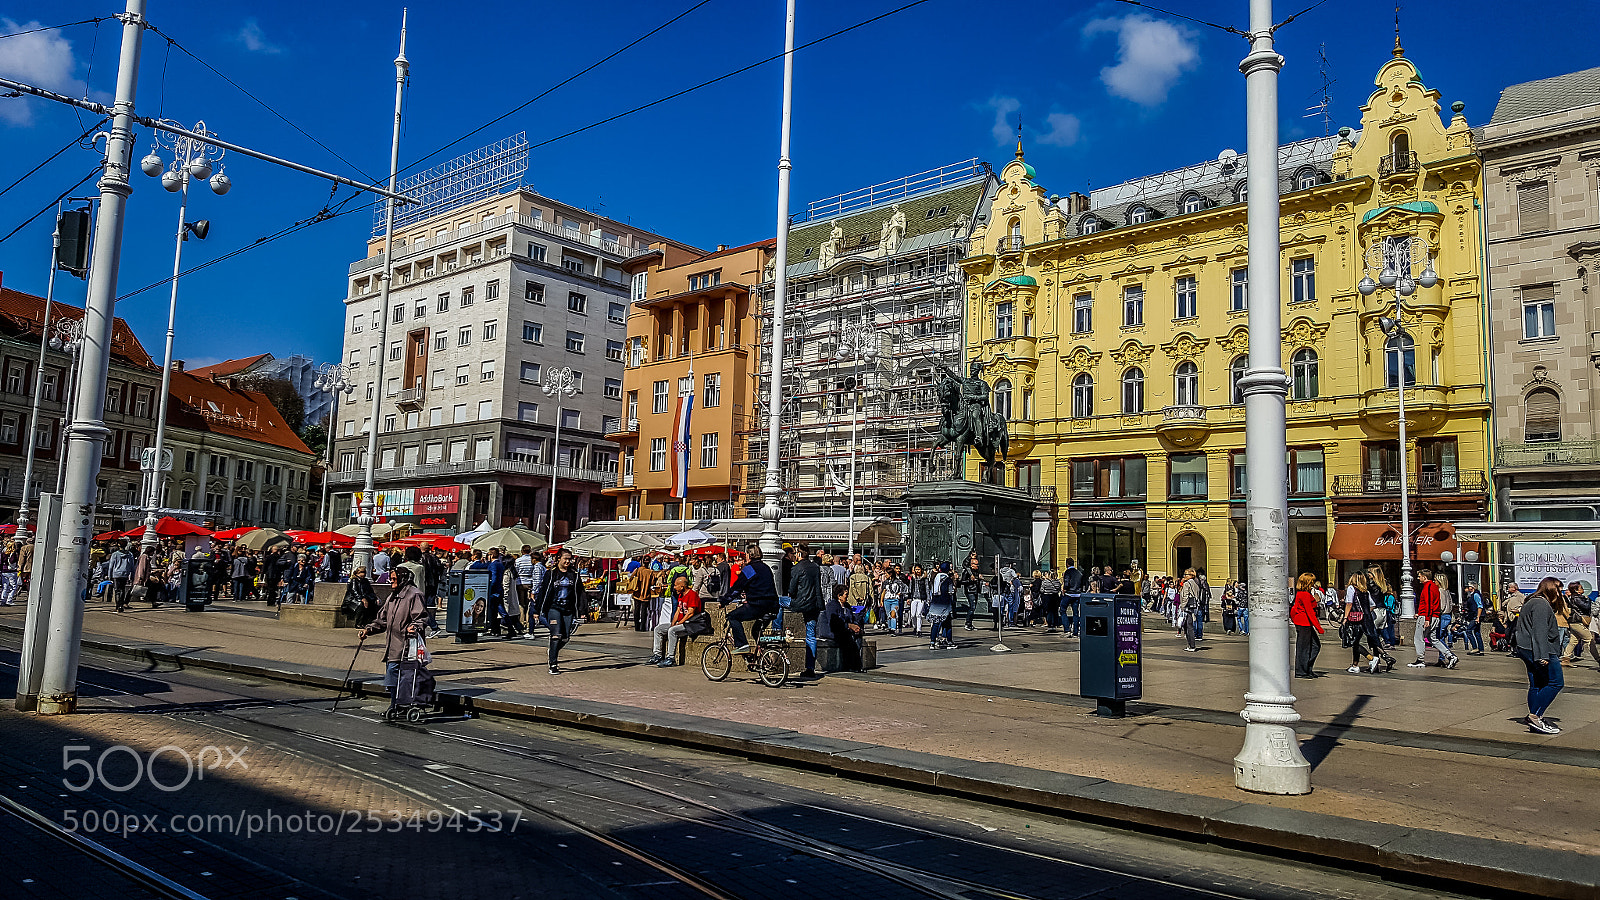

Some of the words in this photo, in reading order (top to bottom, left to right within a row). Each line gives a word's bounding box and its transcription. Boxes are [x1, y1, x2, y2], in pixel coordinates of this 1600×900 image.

[1087, 510, 1128, 519] HARMICA
[1518, 553, 1567, 562] PROMJENA
[1116, 616, 1139, 625] EXCHANGE
